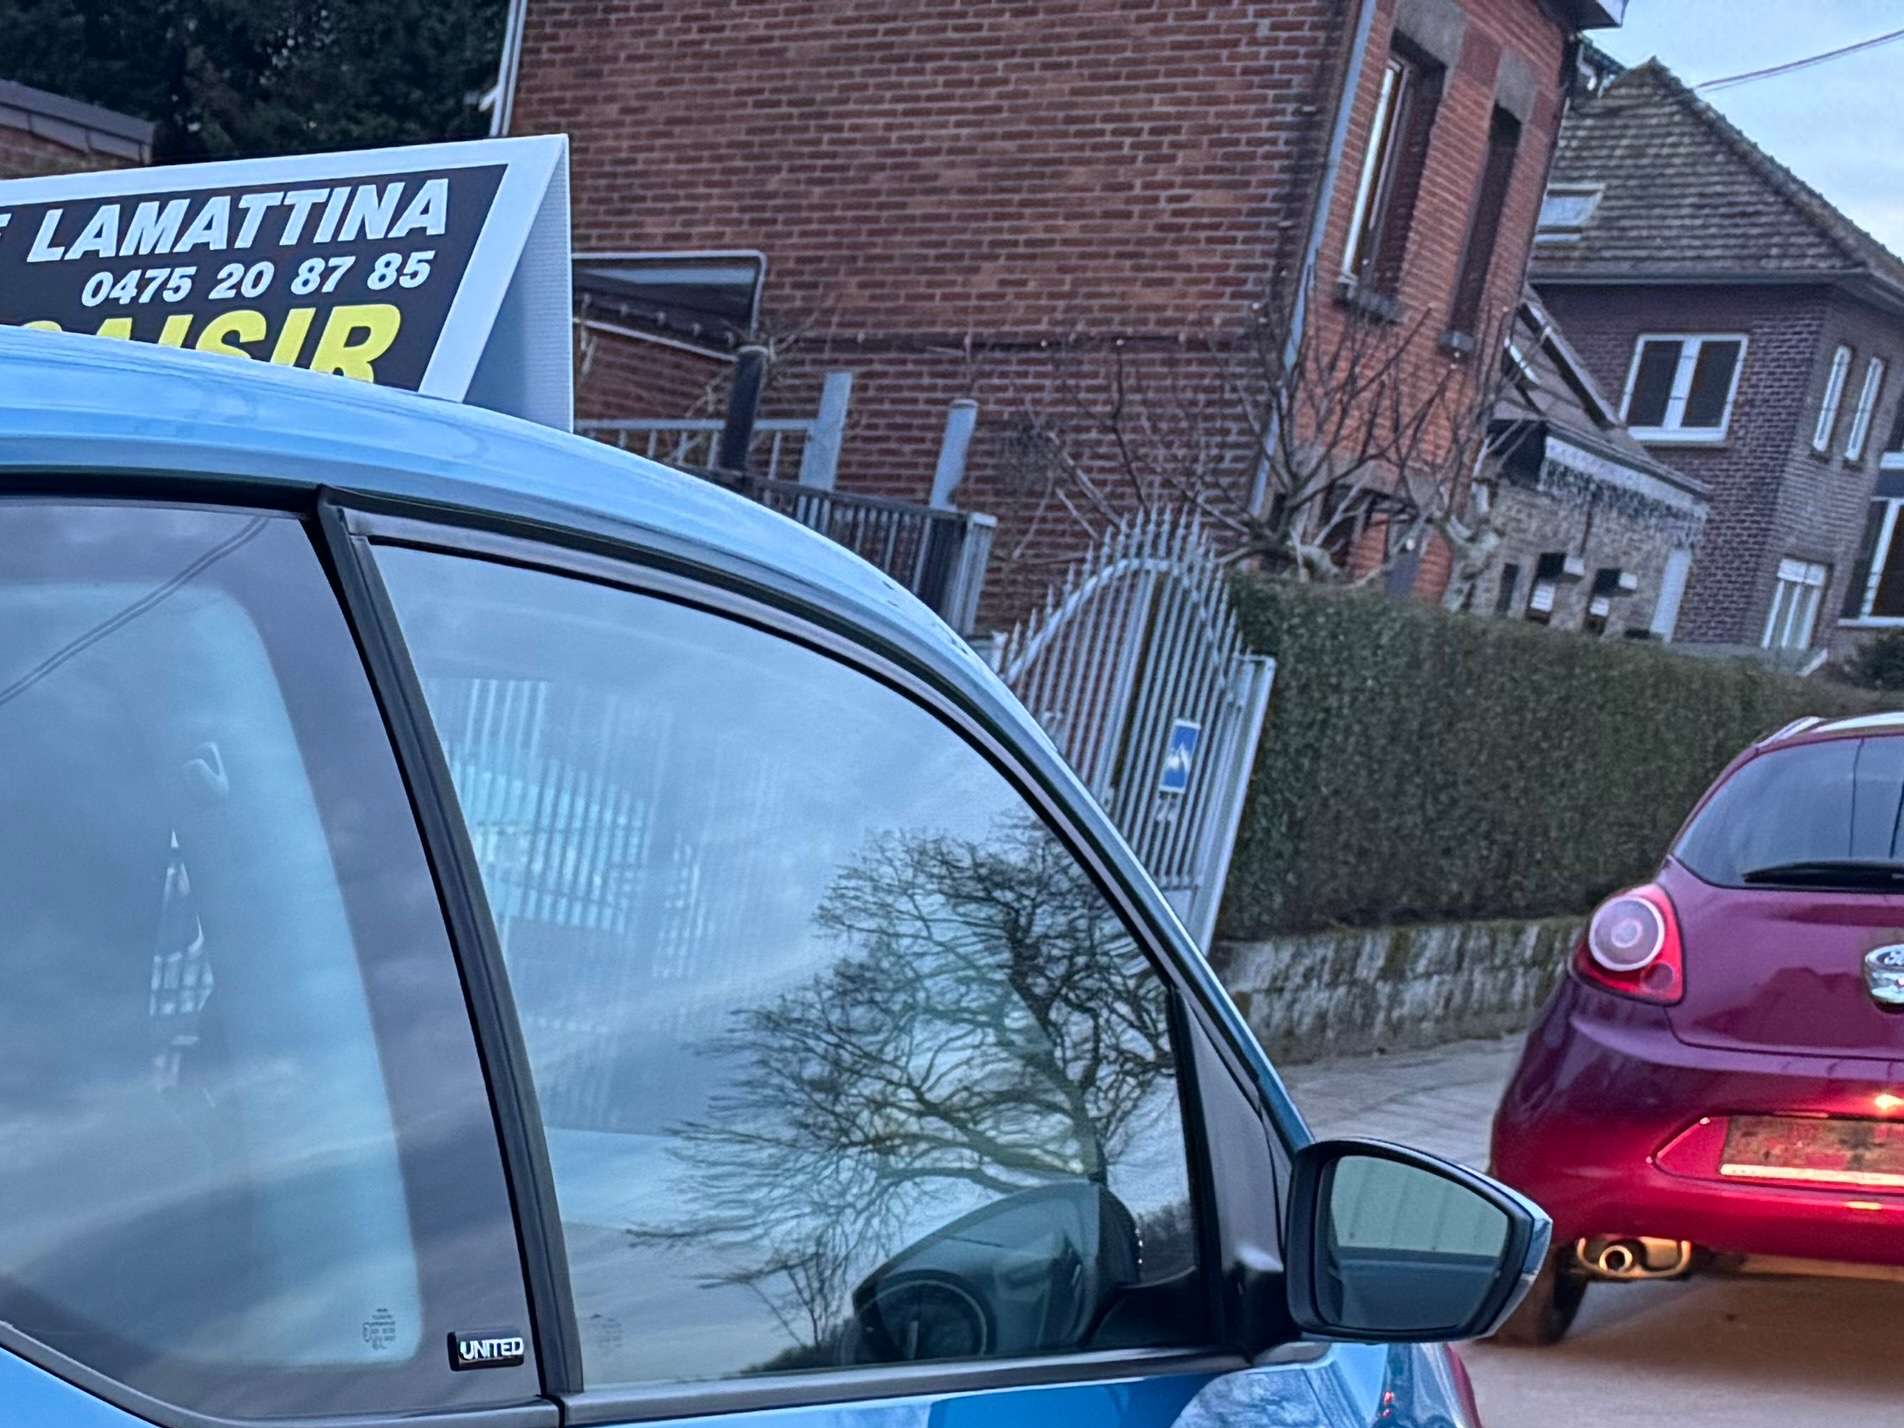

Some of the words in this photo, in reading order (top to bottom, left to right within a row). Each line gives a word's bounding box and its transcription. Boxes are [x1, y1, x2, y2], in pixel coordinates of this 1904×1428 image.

[26, 177, 450, 263] LAMATTINA
[80, 265, 197, 308] 0475
[207, 260, 275, 300] 20
[290, 255, 356, 296] 87
[366, 249, 436, 291] 85
[459, 1336, 525, 1361] UNITED
